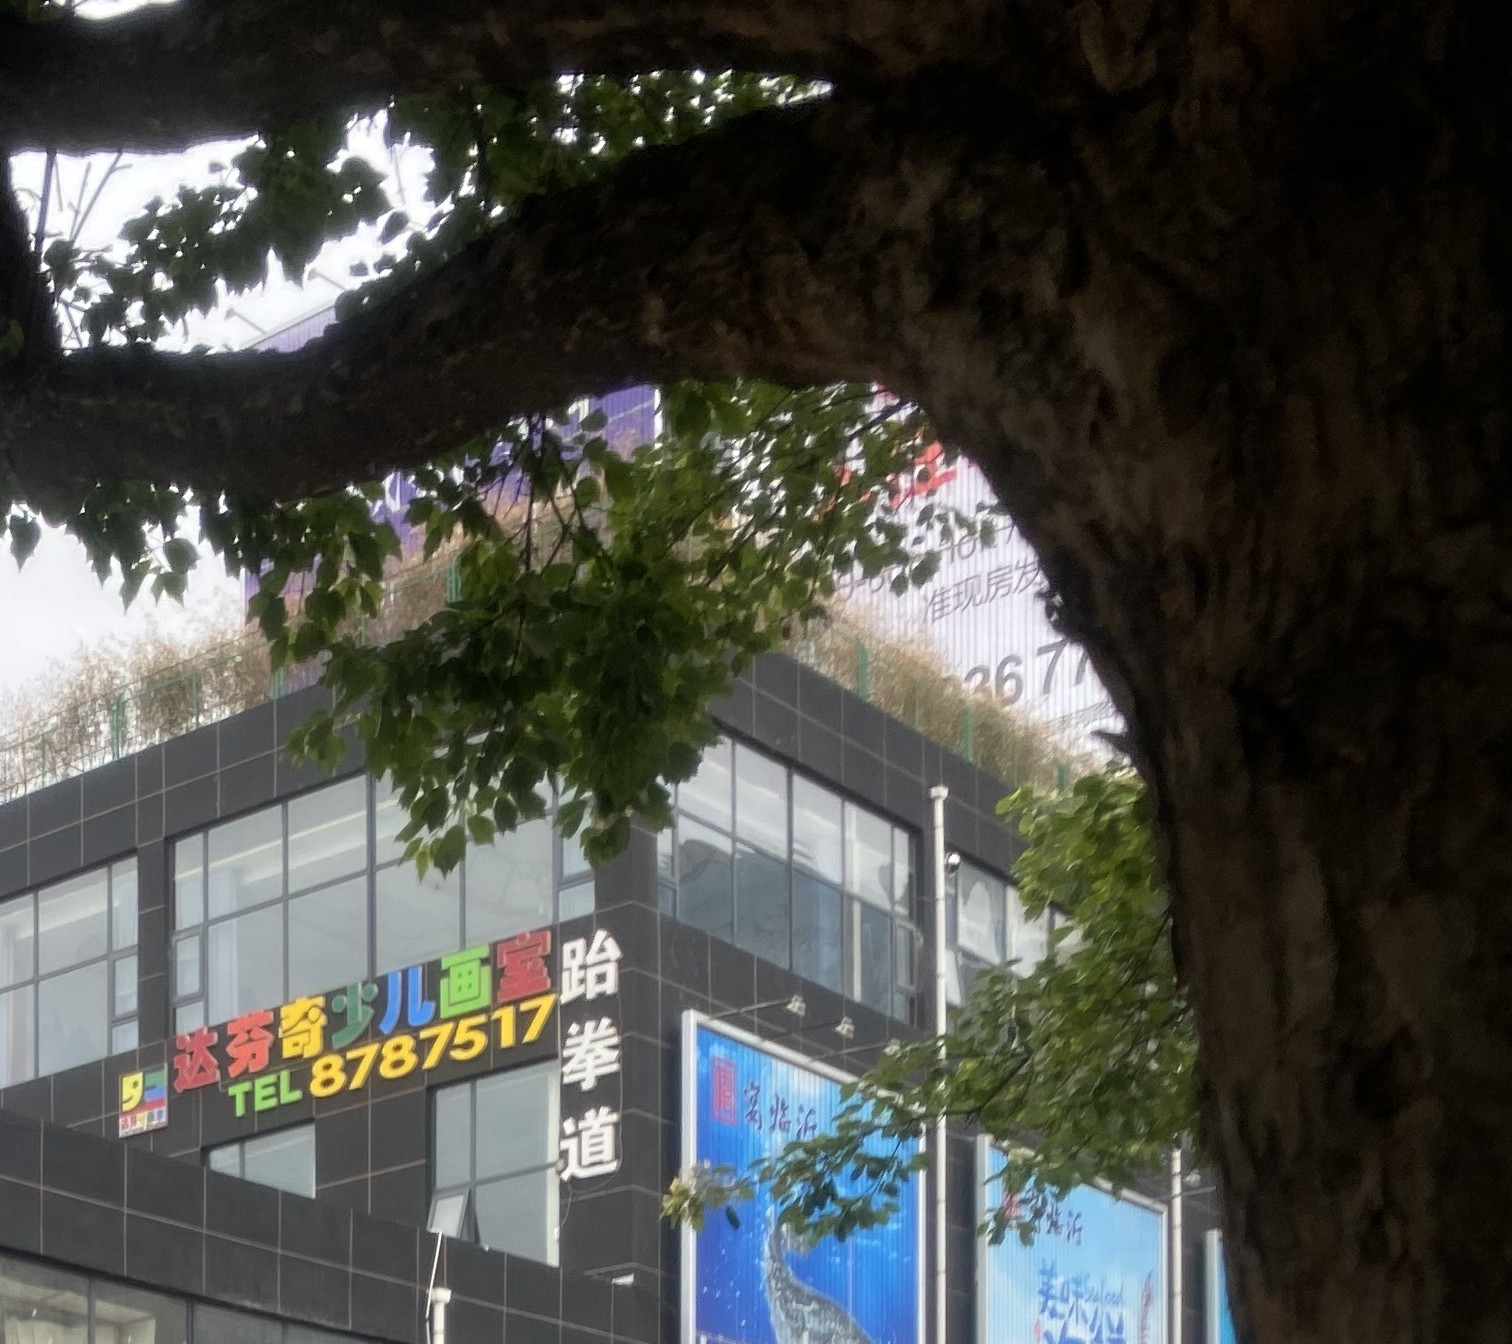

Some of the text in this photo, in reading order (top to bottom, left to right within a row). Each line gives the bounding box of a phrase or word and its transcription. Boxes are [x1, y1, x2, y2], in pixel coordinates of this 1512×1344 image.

[172, 929, 552, 1094] 达芬奇少儿画室
[228, 993, 557, 1118] TEL 8787517
[559, 928, 623, 1183] 跆拳道
